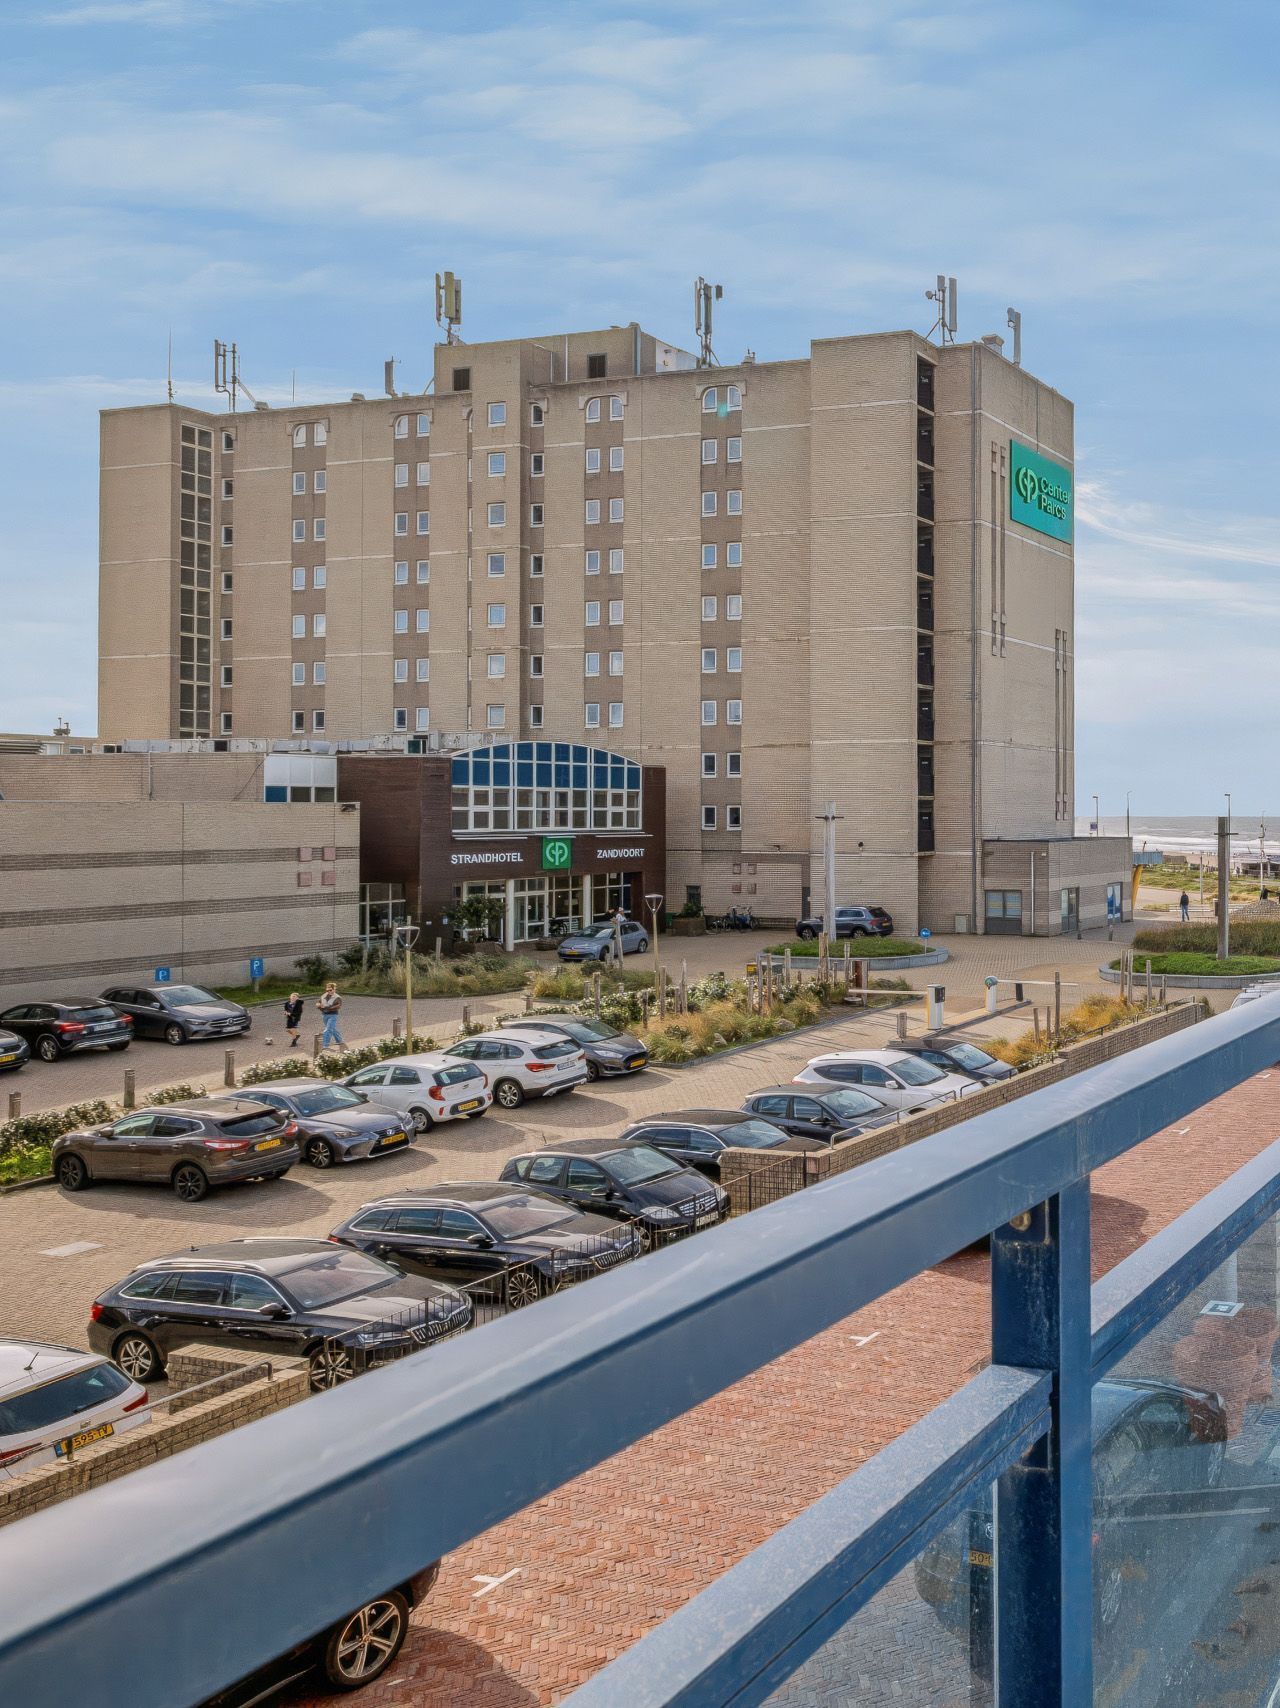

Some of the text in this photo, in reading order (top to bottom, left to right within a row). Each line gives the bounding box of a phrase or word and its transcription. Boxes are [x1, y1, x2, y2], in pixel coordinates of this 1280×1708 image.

[1041, 477, 1070, 503] Center
[1041, 494, 1067, 520] Parcs
[451, 848, 645, 865] STRANDHOTEL ZANDVOORT
[160, 970, 167, 980] P
